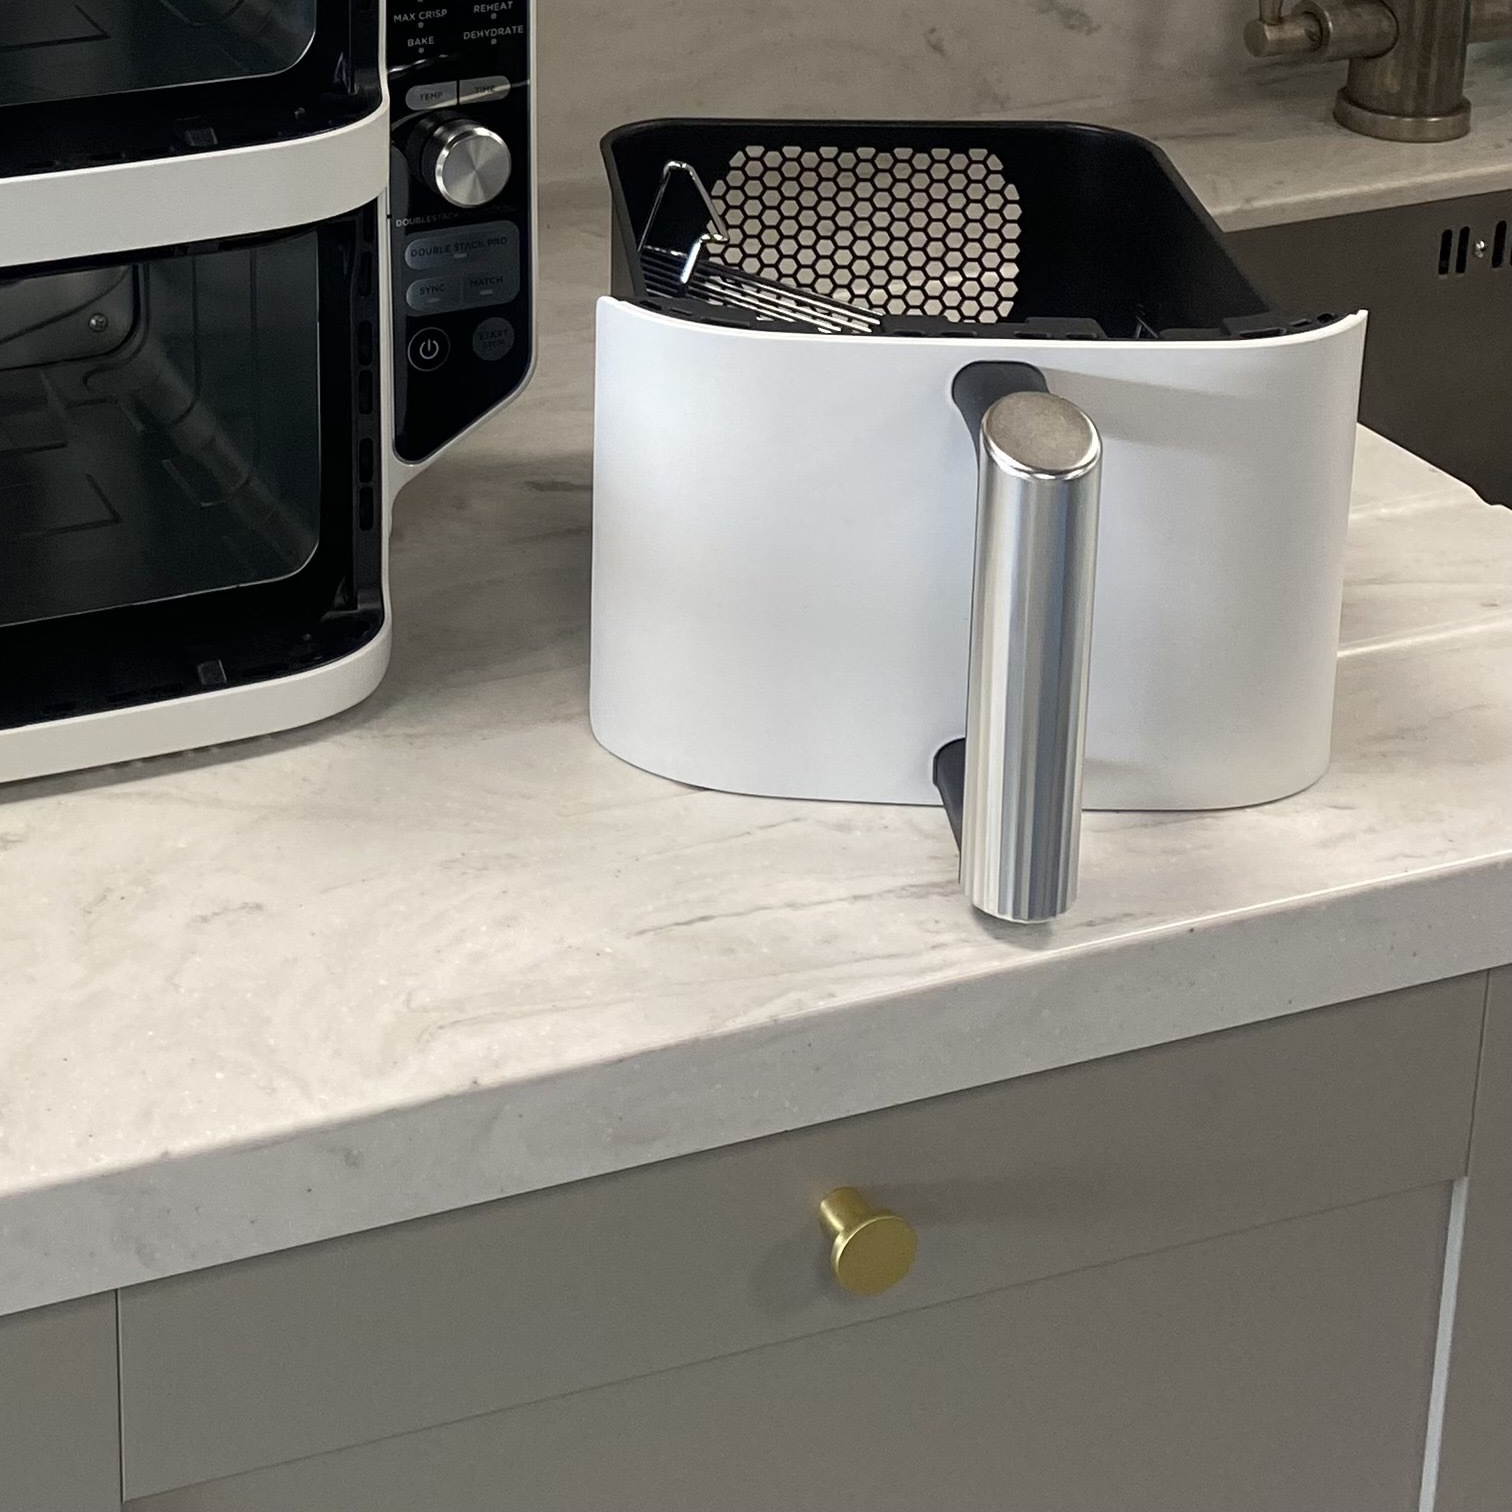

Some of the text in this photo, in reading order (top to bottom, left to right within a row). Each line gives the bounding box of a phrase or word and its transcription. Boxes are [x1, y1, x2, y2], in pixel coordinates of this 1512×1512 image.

[473, 1, 514, 13] REHEAT
[393, 9, 448, 23] MAX CRISP
[463, 25, 524, 40] DEHYDRATE
[407, 36, 435, 47] BAKE
[419, 91, 443, 102] TEMP
[411, 236, 508, 258] DOUBLE STACK PRO
[469, 275, 504, 288] MATCH
[419, 283, 446, 296] SYNC
